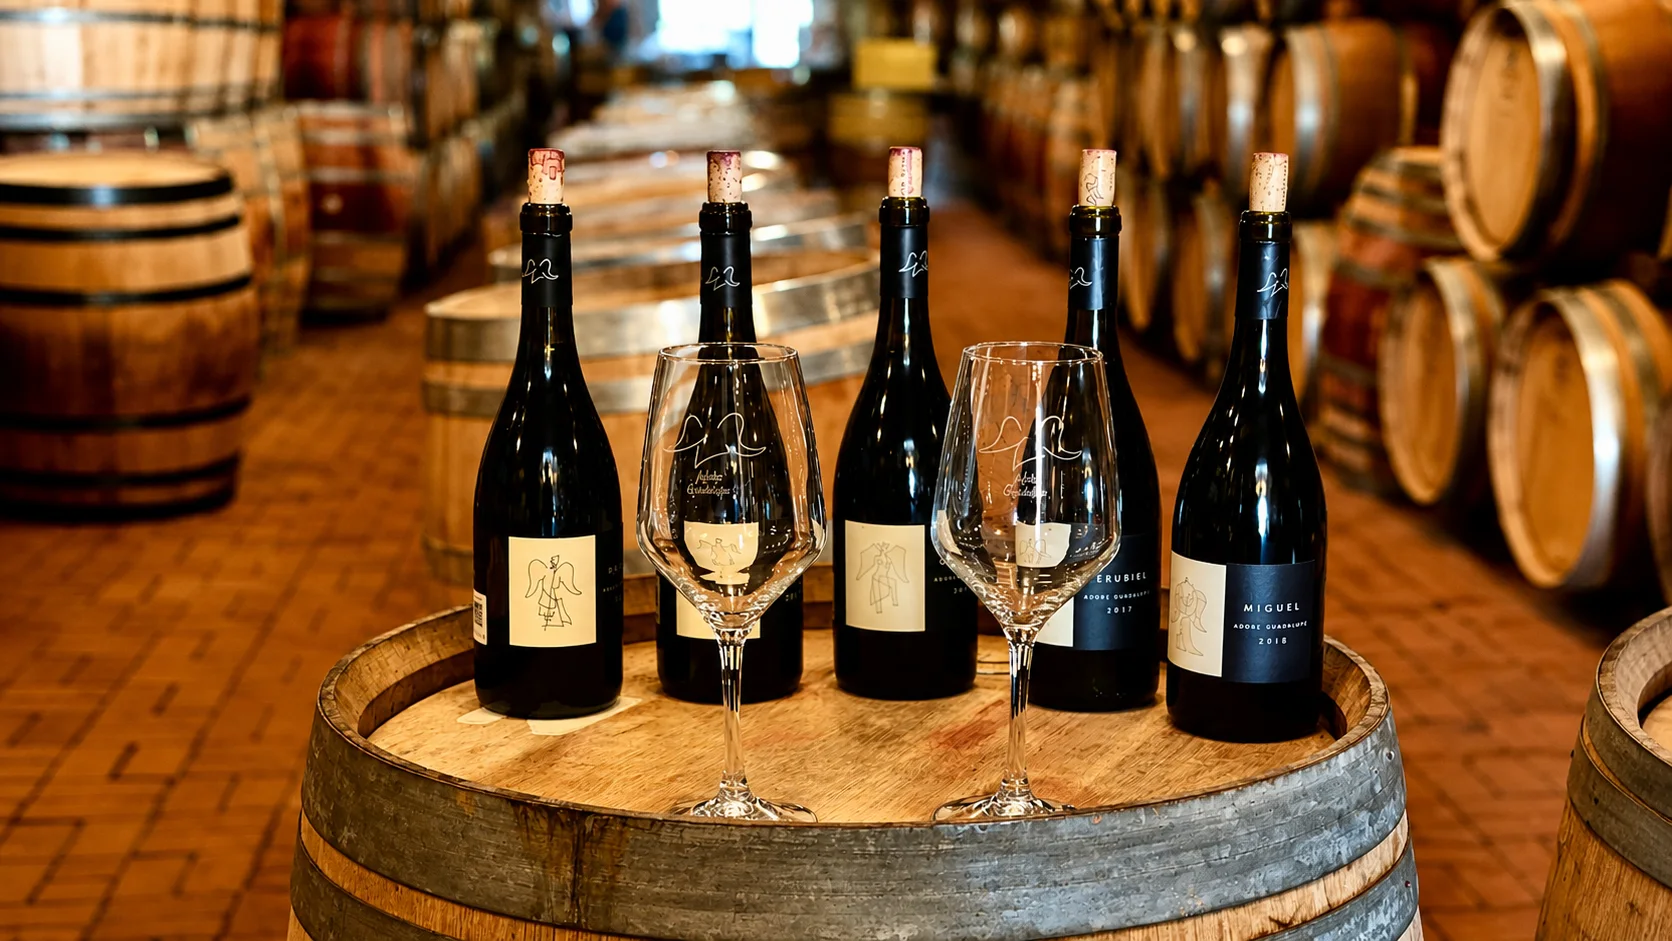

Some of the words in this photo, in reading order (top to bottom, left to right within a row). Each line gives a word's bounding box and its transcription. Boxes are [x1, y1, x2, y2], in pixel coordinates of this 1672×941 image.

[1096, 571, 1147, 583] ERUBIEL
[1107, 606, 1132, 614] 2017
[1243, 602, 1300, 613] MIGUEL
[1233, 623, 1261, 631] ADOBE
[1265, 620, 1308, 630] GUADALUPE
[1258, 637, 1287, 645] 2018
